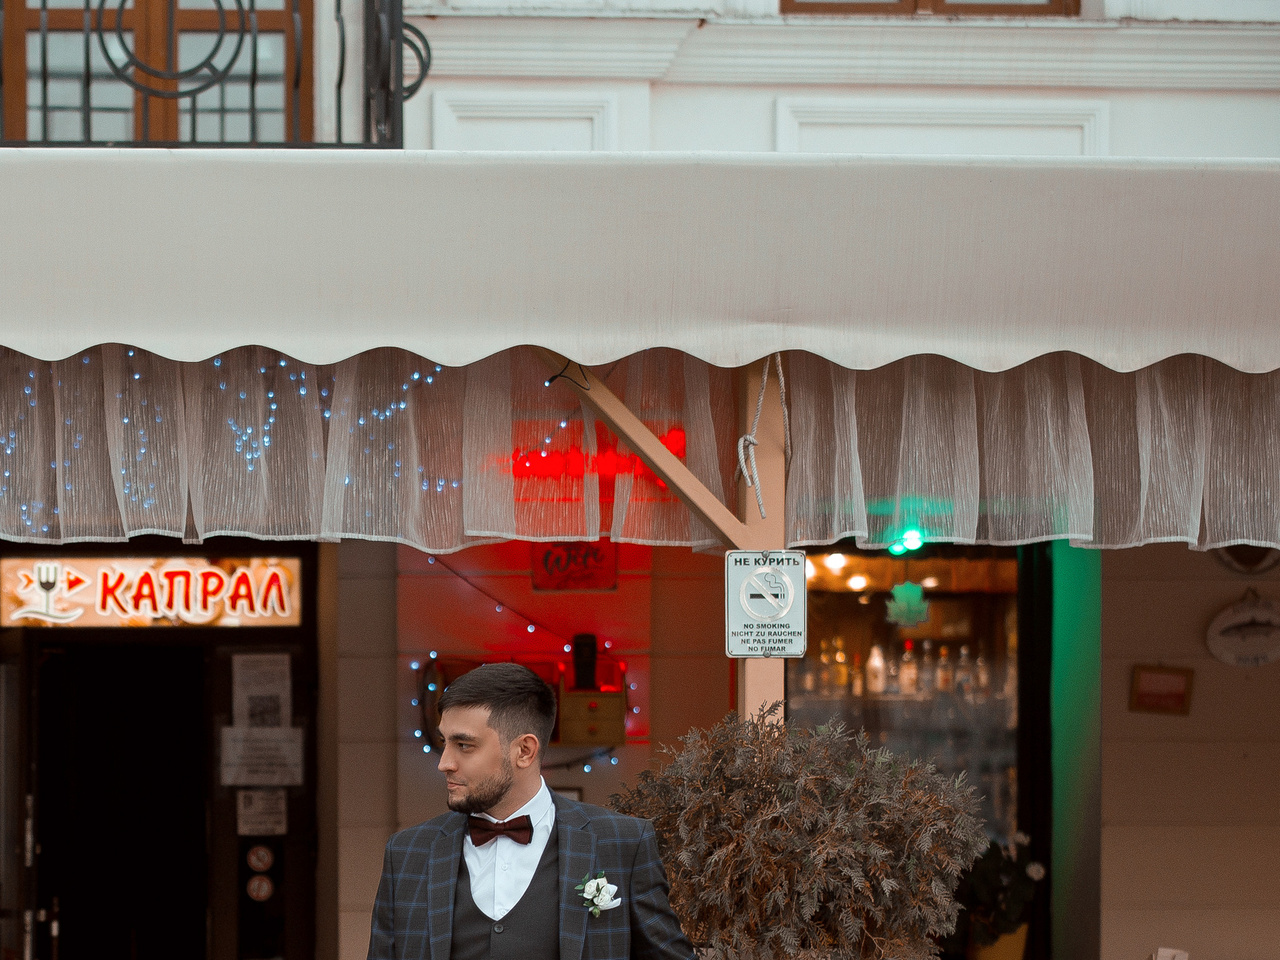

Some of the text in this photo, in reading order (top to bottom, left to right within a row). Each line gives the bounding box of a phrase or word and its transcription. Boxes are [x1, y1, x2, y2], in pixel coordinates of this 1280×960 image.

[734, 557, 800, 566] НЕ КУРИТЬ
[99, 569, 288, 616] КАПРАЛ
